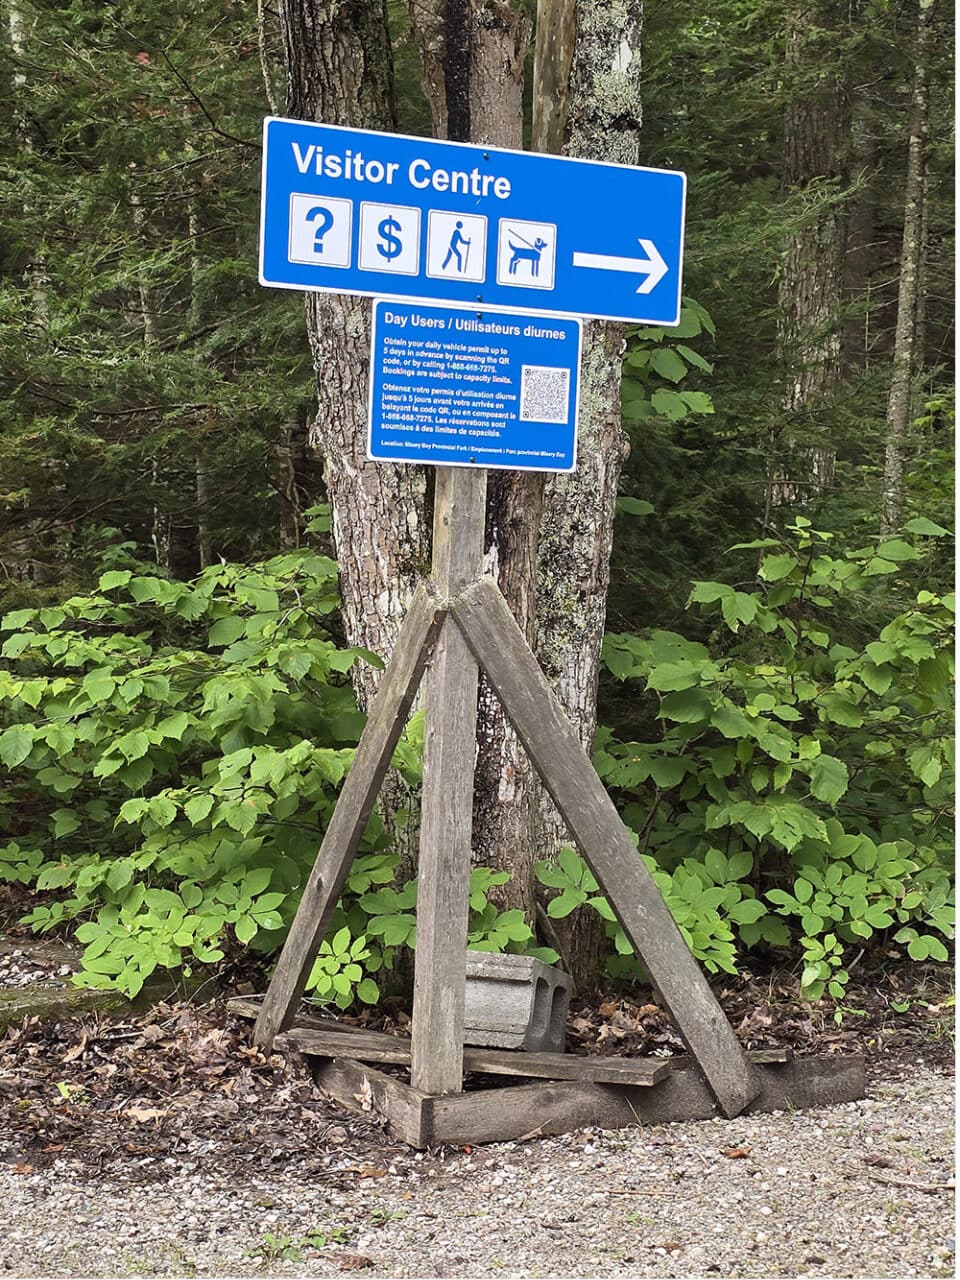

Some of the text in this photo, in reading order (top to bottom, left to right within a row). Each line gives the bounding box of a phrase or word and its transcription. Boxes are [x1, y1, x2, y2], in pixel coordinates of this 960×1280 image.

[292, 143, 511, 199] Visitor Centre
[384, 312, 566, 340] Day Users / Utilisateurs diurnes
[408, 340, 423, 348] your
[425, 341, 441, 350] daily
[443, 343, 466, 351] vehicle
[468, 345, 489, 354] permit
[389, 348, 405, 356] days
[415, 349, 443, 359] advance
[445, 352, 453, 360] by
[455, 353, 485, 364] scanning
[412, 359, 420, 368] by
[423, 360, 445, 369] calling
